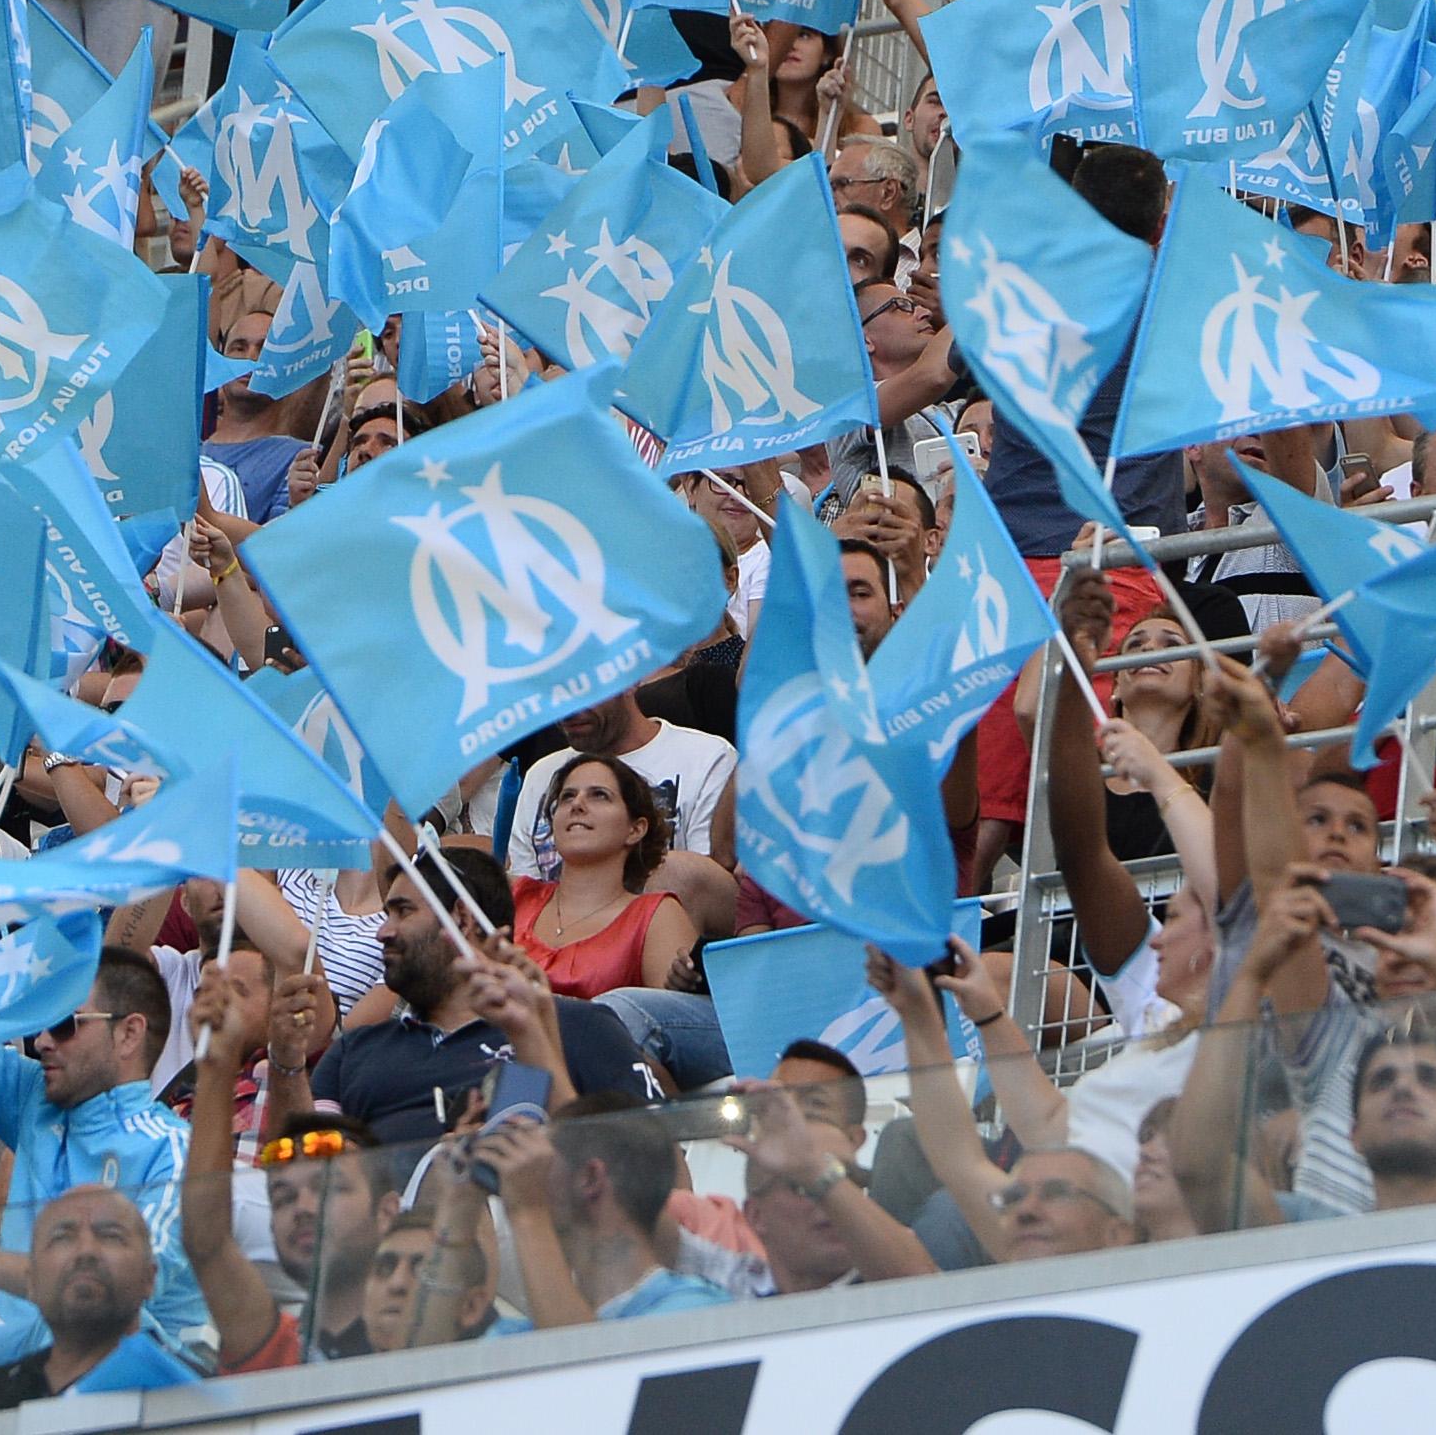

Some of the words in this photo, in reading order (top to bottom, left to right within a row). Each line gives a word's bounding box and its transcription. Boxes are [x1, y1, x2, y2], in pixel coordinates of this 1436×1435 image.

[522, 99, 557, 136] BUT
[52, 384, 77, 413] AU
[74, 343, 113, 387] BUT
[459, 693, 545, 756] DROIT
[547, 671, 590, 704] AU
[595, 641, 651, 687] BUT
